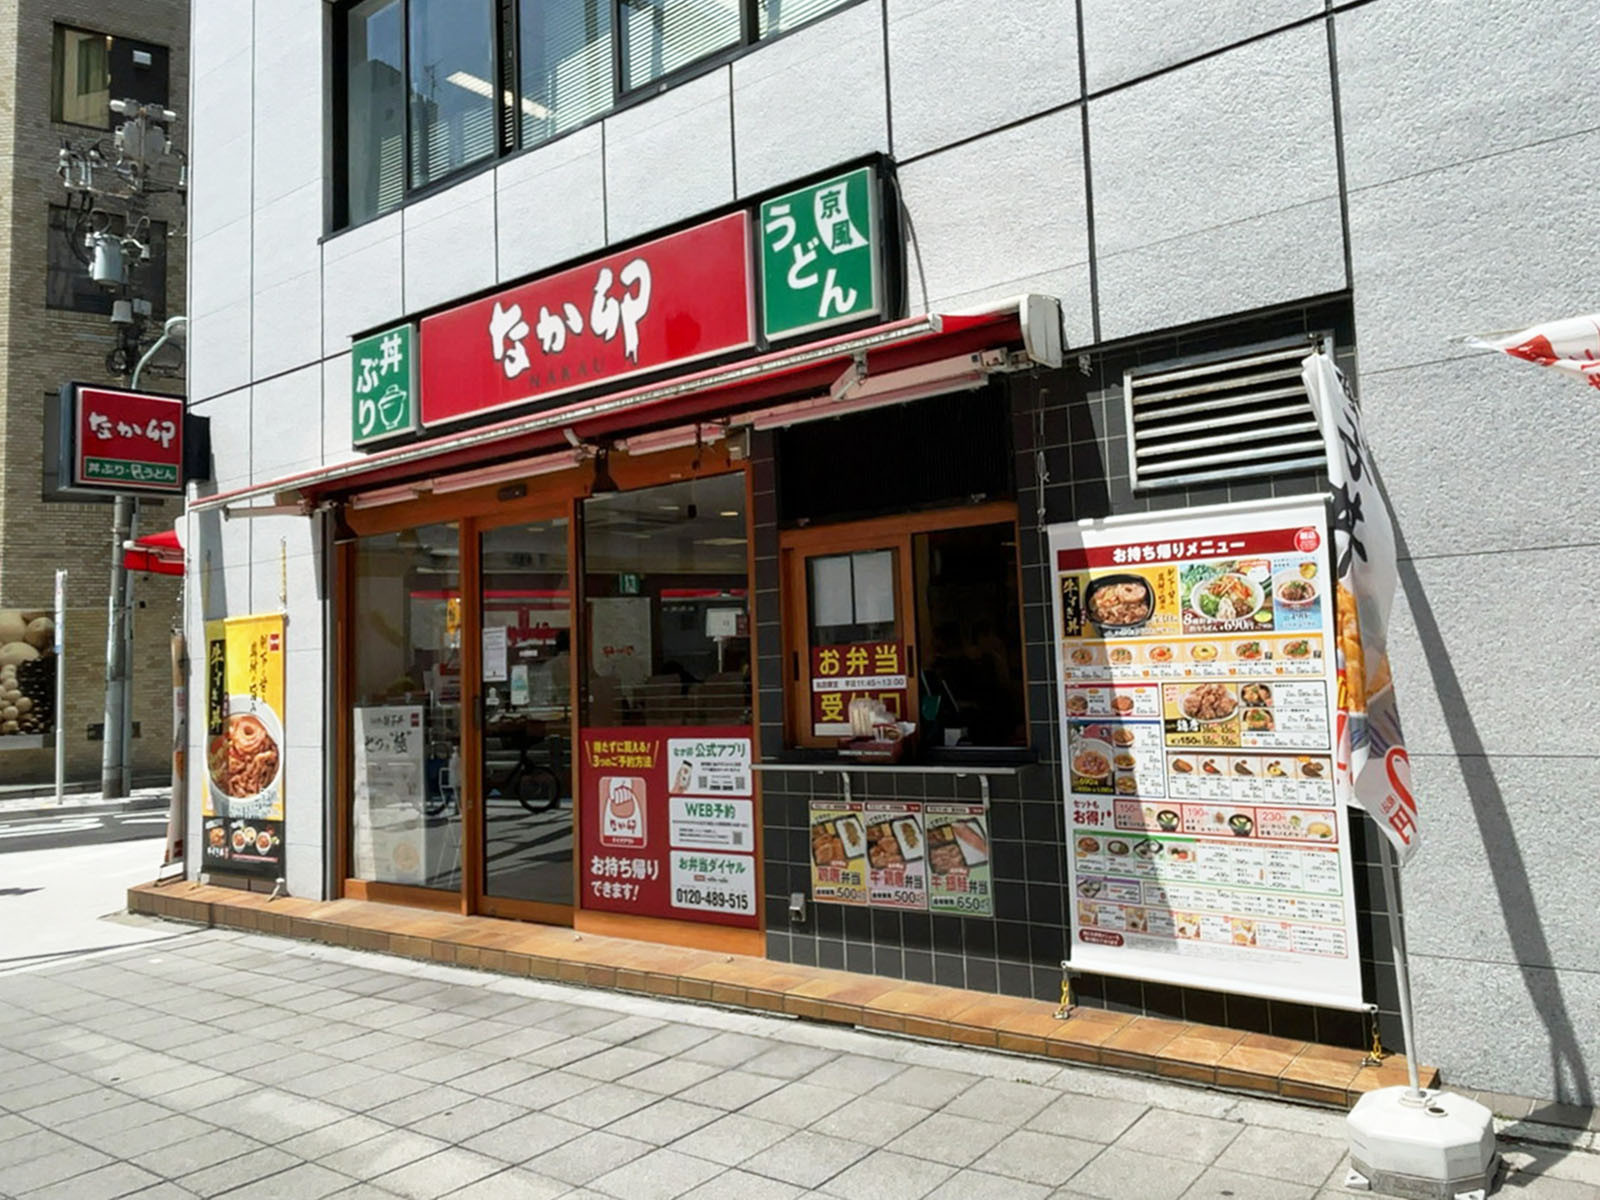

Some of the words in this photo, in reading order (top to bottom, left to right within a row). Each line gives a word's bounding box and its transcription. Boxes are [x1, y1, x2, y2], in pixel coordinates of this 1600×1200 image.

[820, 190, 852, 250] 京風
[765, 204, 857, 318] うどん
[488, 257, 651, 379] なか卯
[356, 332, 403, 436] 丼ぶり
[88, 411, 176, 449] なか卯
[1112, 540, 1246, 564] お持ち帰りメニュー
[818, 644, 899, 675] お弁当
[821, 692, 901, 721] 受口
[695, 742, 746, 758] 公式アプリ
[684, 802, 736, 820] WEB予約
[591, 855, 659, 881] お持ち帰り
[678, 857, 746, 875] お弁当ダイヤル
[591, 881, 640, 901] できます!
[676, 887, 749, 911] 0120-489-515
